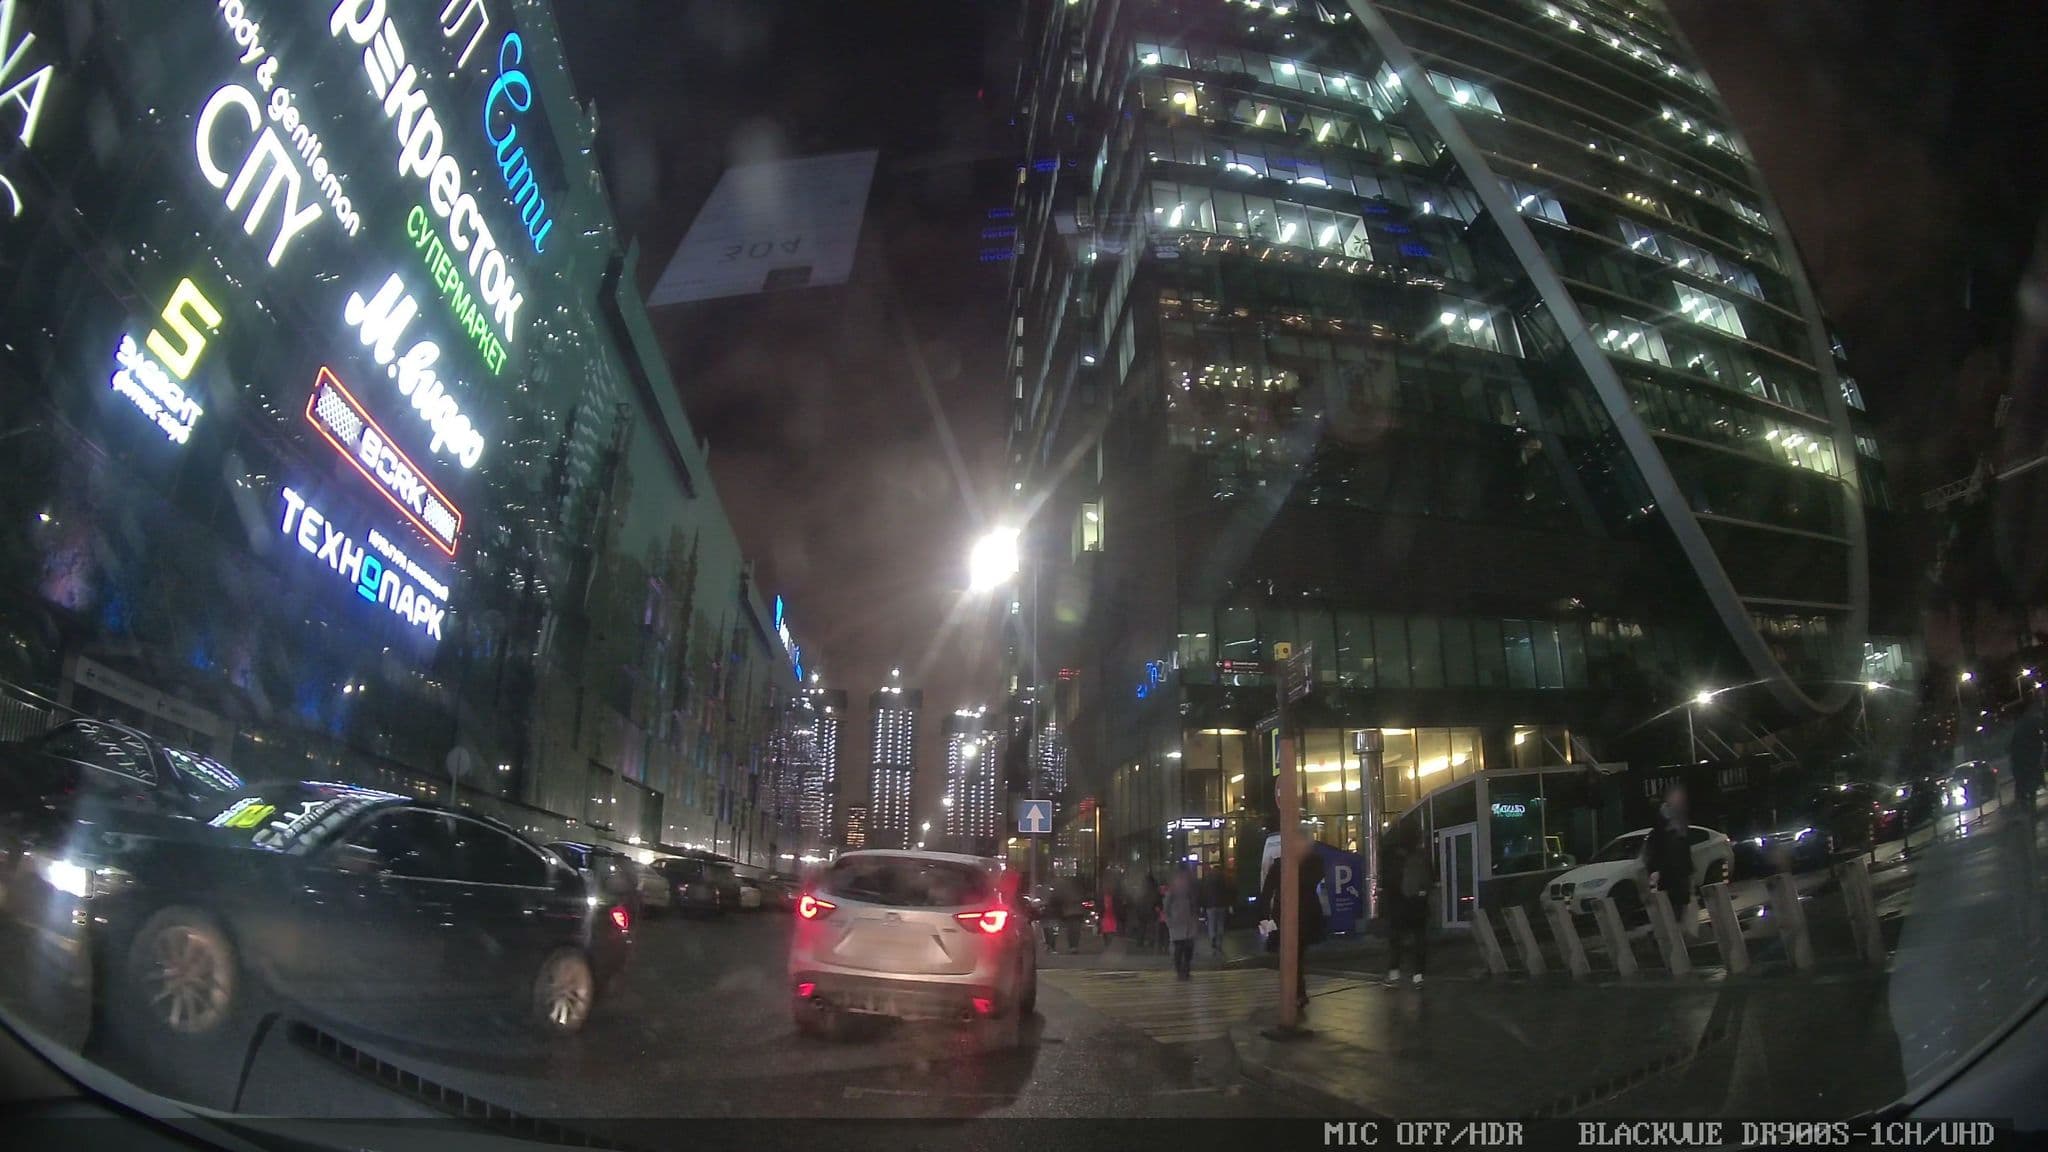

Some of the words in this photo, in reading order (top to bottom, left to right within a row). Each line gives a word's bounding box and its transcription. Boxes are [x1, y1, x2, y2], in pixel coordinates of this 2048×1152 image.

[195, 84, 323, 267] CITY
[267, 86, 360, 237] gentleman
[407, 205, 508, 376] СУПЕРМАРКЕТ
[281, 486, 445, 641] ТЕХНОПАРК
[1335, 865, 1353, 895] P
